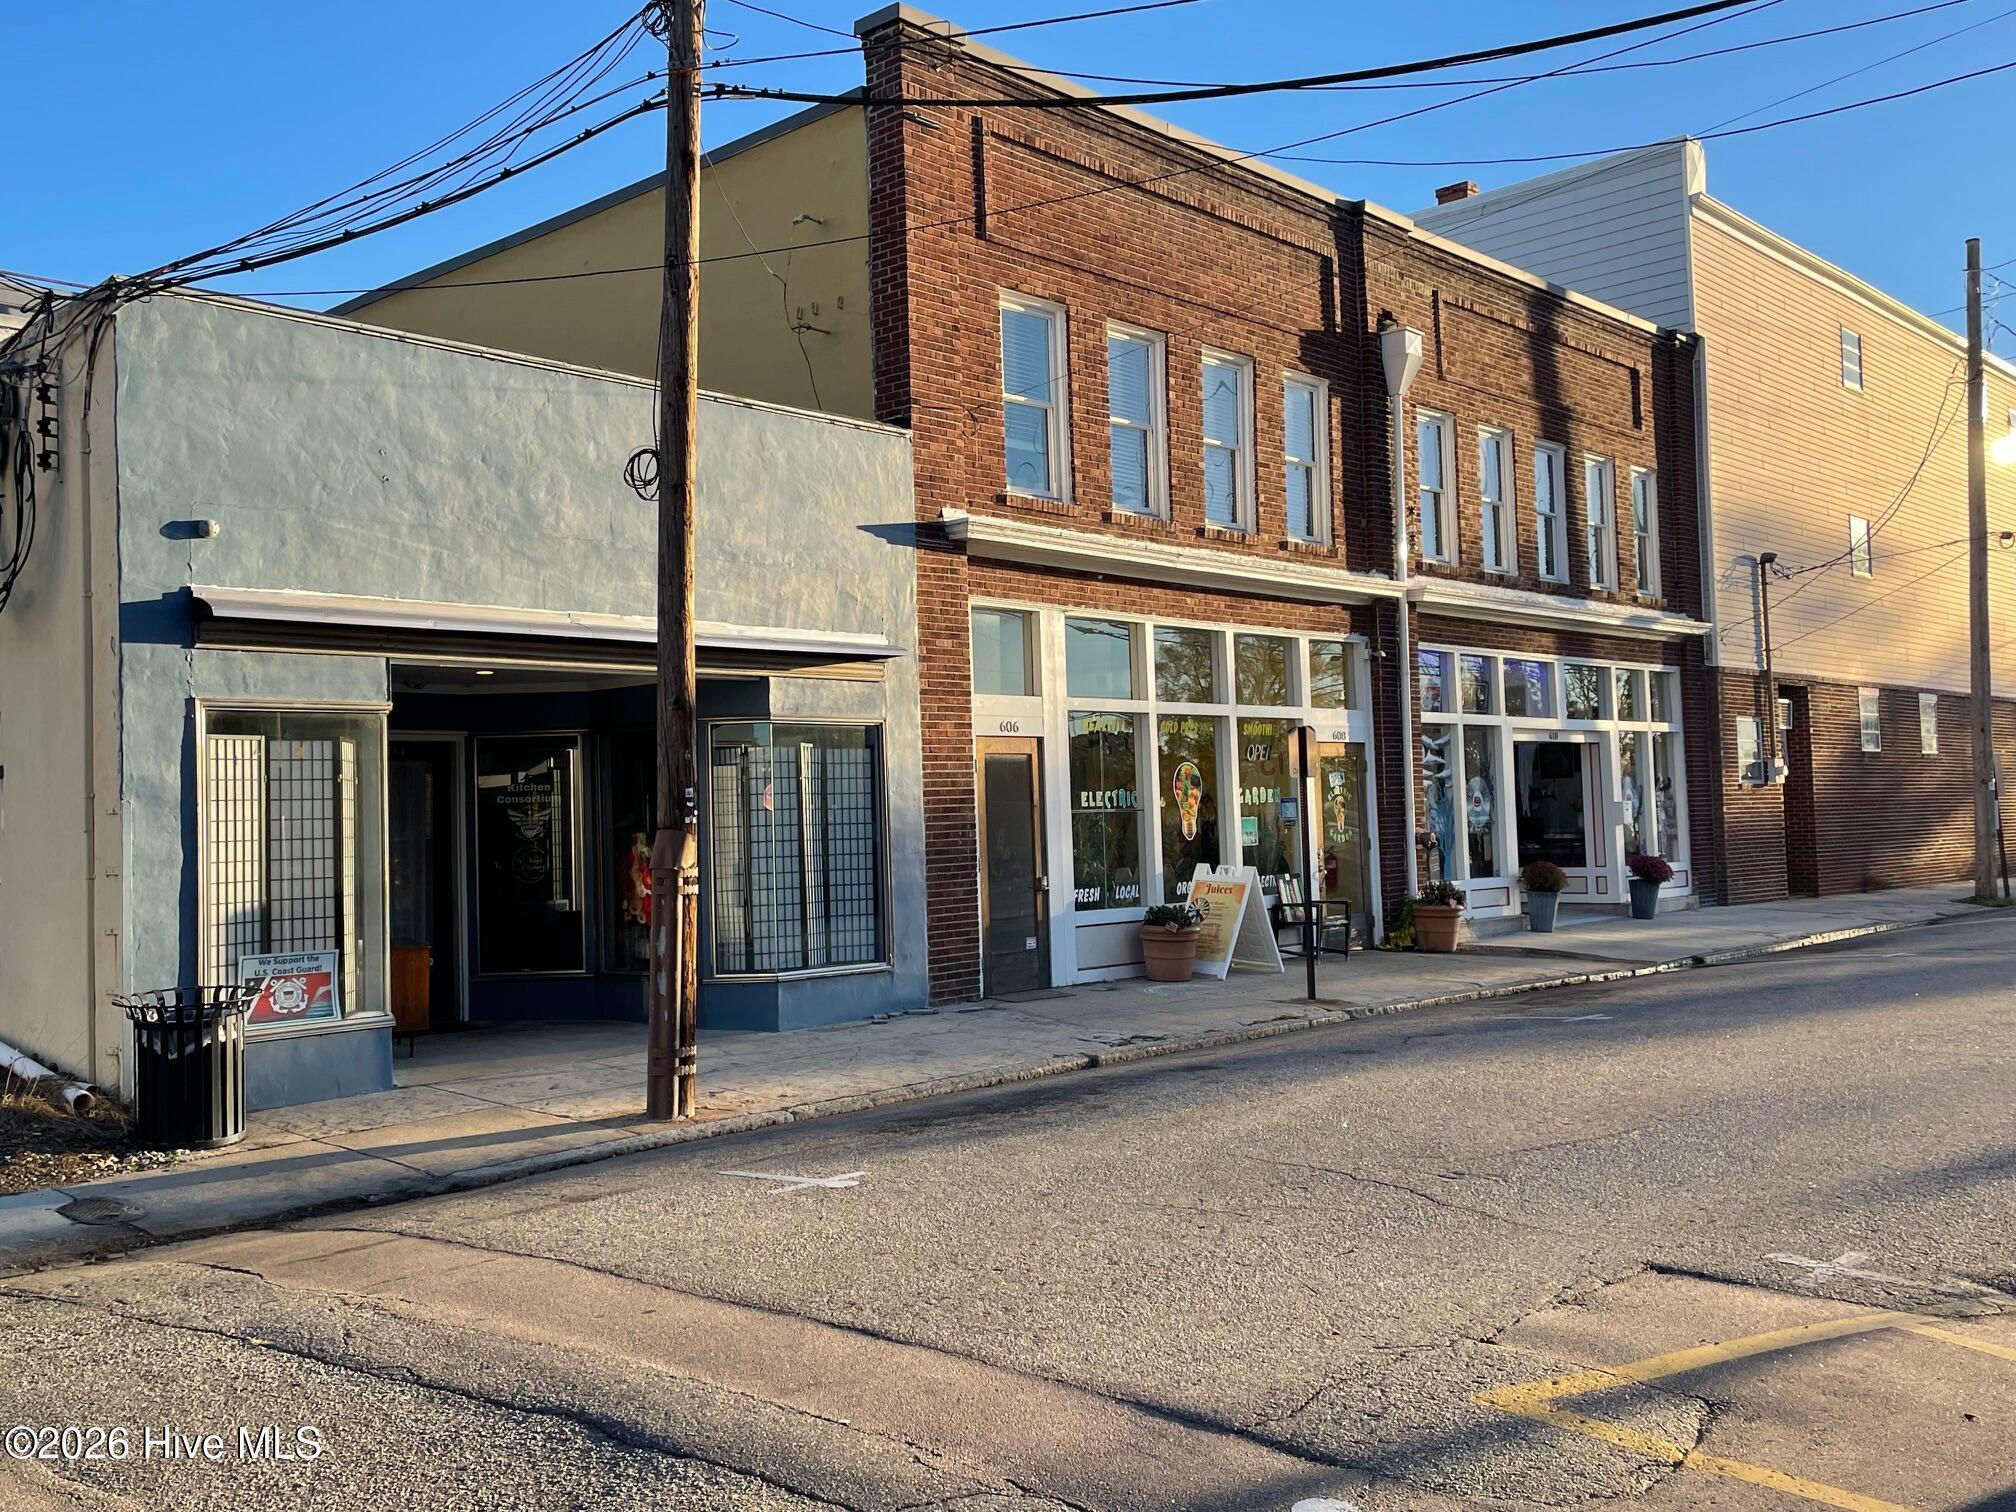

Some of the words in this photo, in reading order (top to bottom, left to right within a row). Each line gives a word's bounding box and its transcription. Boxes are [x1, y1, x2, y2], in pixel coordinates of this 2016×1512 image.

[999, 720, 1019, 733] 606
[1242, 722, 1280, 736] SMOOTHI
[1332, 730, 1347, 741] 608
[1549, 732, 1559, 740] 610
[1246, 744, 1273, 762] OPEN
[507, 783, 551, 792] Kitchen
[496, 793, 562, 804] Consortium
[1080, 788, 1138, 809] ELECTRIC
[1239, 786, 1281, 806] GARDEN
[1074, 886, 1101, 903] FRESH
[1115, 884, 1140, 899] LOCAL
[1176, 881, 1192, 896] ORG
[1205, 883, 1233, 895] Juices
[259, 958, 271, 966] We
[273, 955, 305, 966] Support
[254, 969, 270, 977] U.S.
[271, 967, 294, 976] Coast
[295, 964, 323, 974] Guard!
